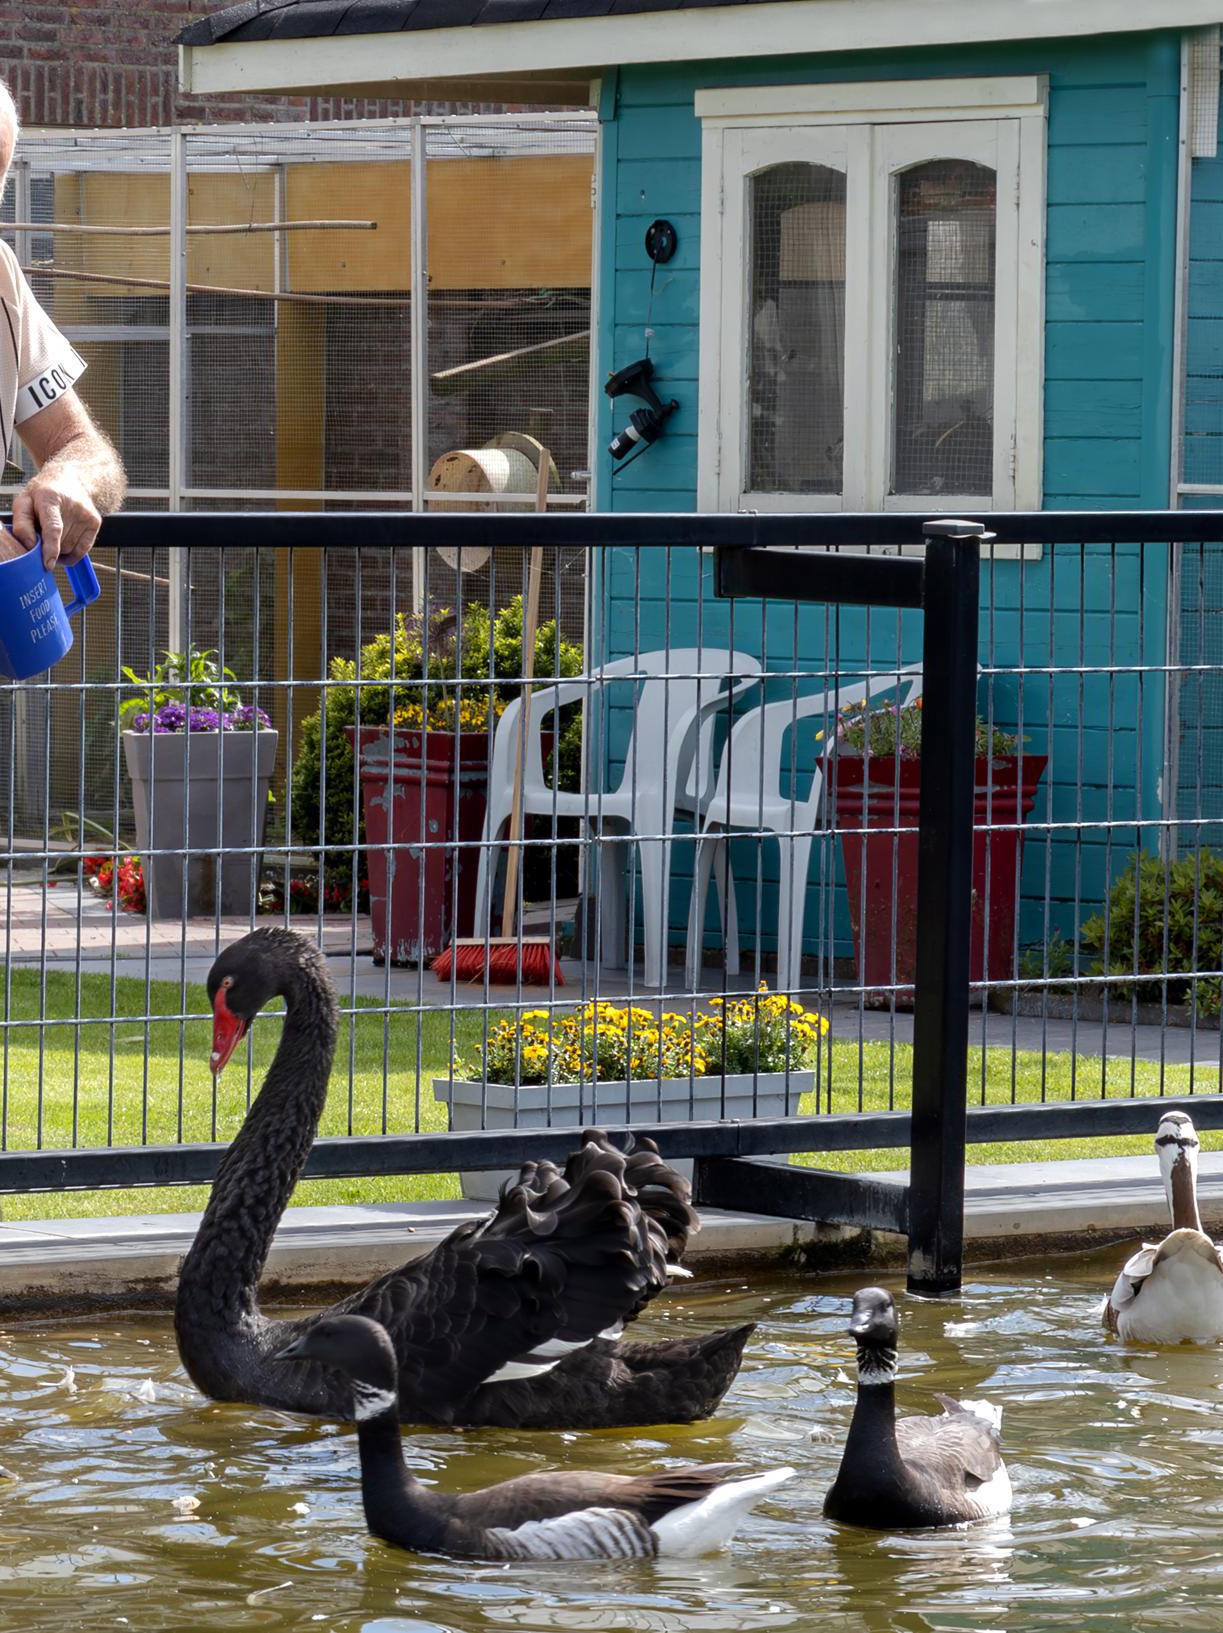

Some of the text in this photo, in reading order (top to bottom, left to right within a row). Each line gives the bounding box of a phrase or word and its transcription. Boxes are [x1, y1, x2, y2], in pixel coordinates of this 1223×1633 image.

[19, 579, 47, 609] INSERT
[30, 600, 50, 622] FOOD
[30, 613, 58, 643] PLEASE
